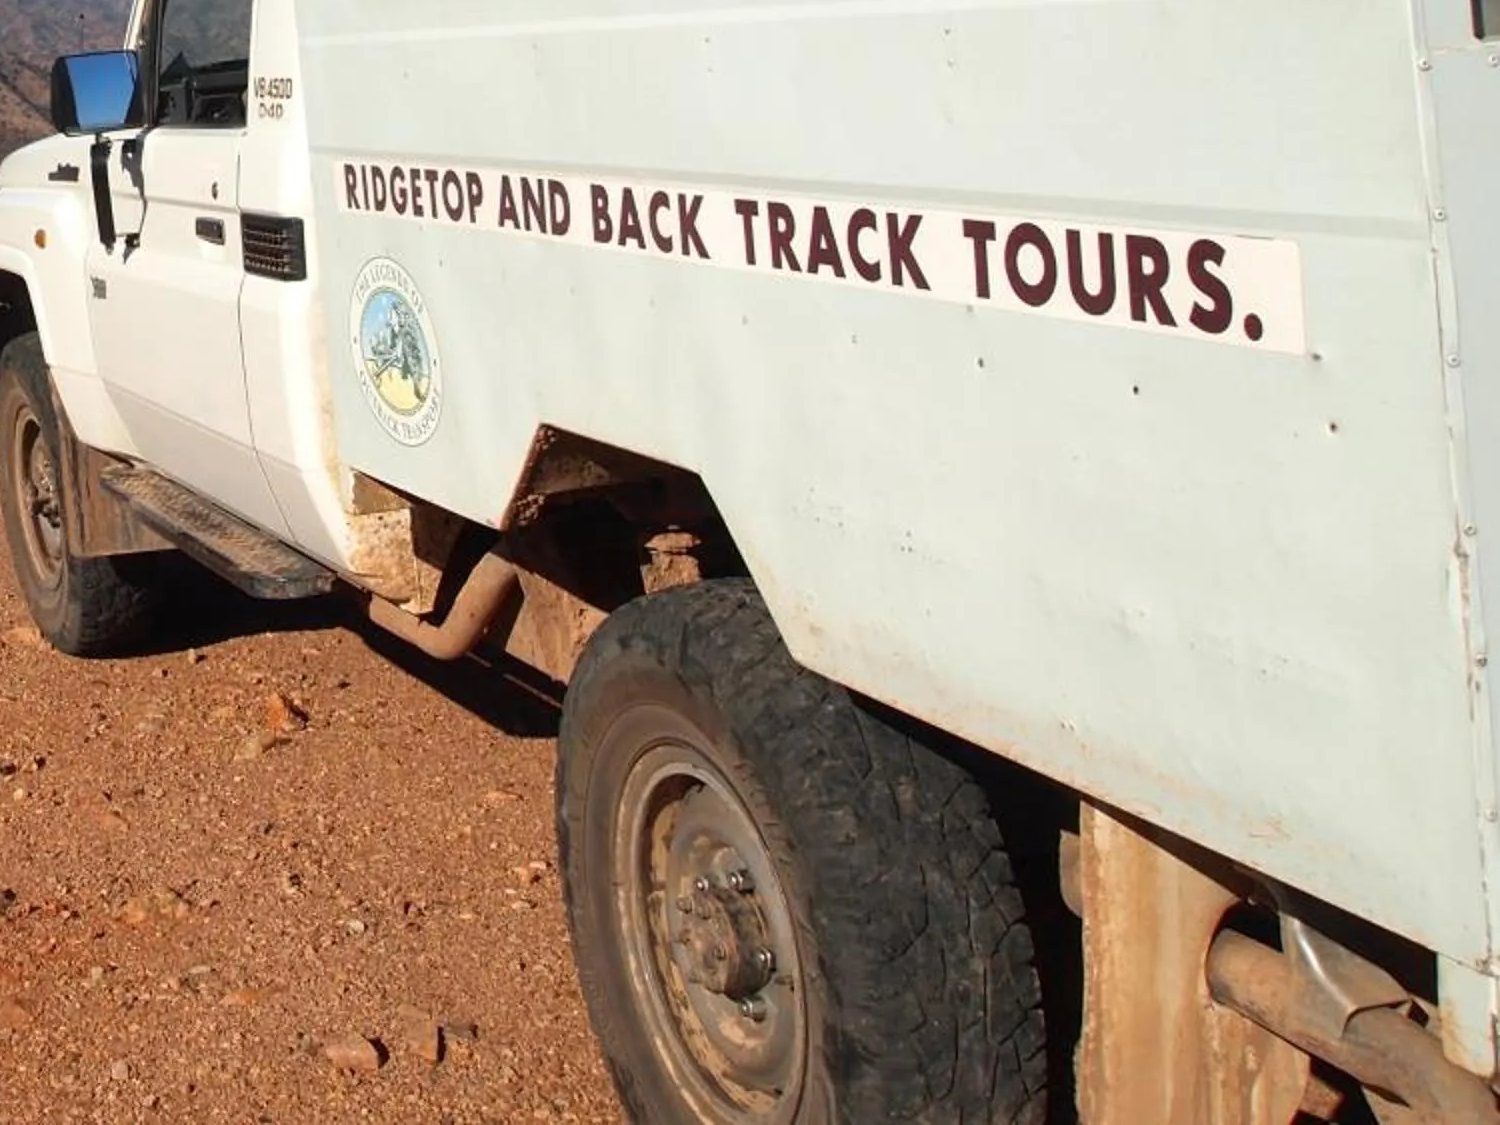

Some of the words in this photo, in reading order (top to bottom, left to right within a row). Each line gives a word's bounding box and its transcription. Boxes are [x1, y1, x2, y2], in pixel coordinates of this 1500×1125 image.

[343, 162, 483, 224] RIDGETOP
[498, 174, 571, 236] AND
[590, 183, 711, 260] BACK
[734, 197, 931, 291] TRACK
[962, 218, 1264, 342] TOURS.
